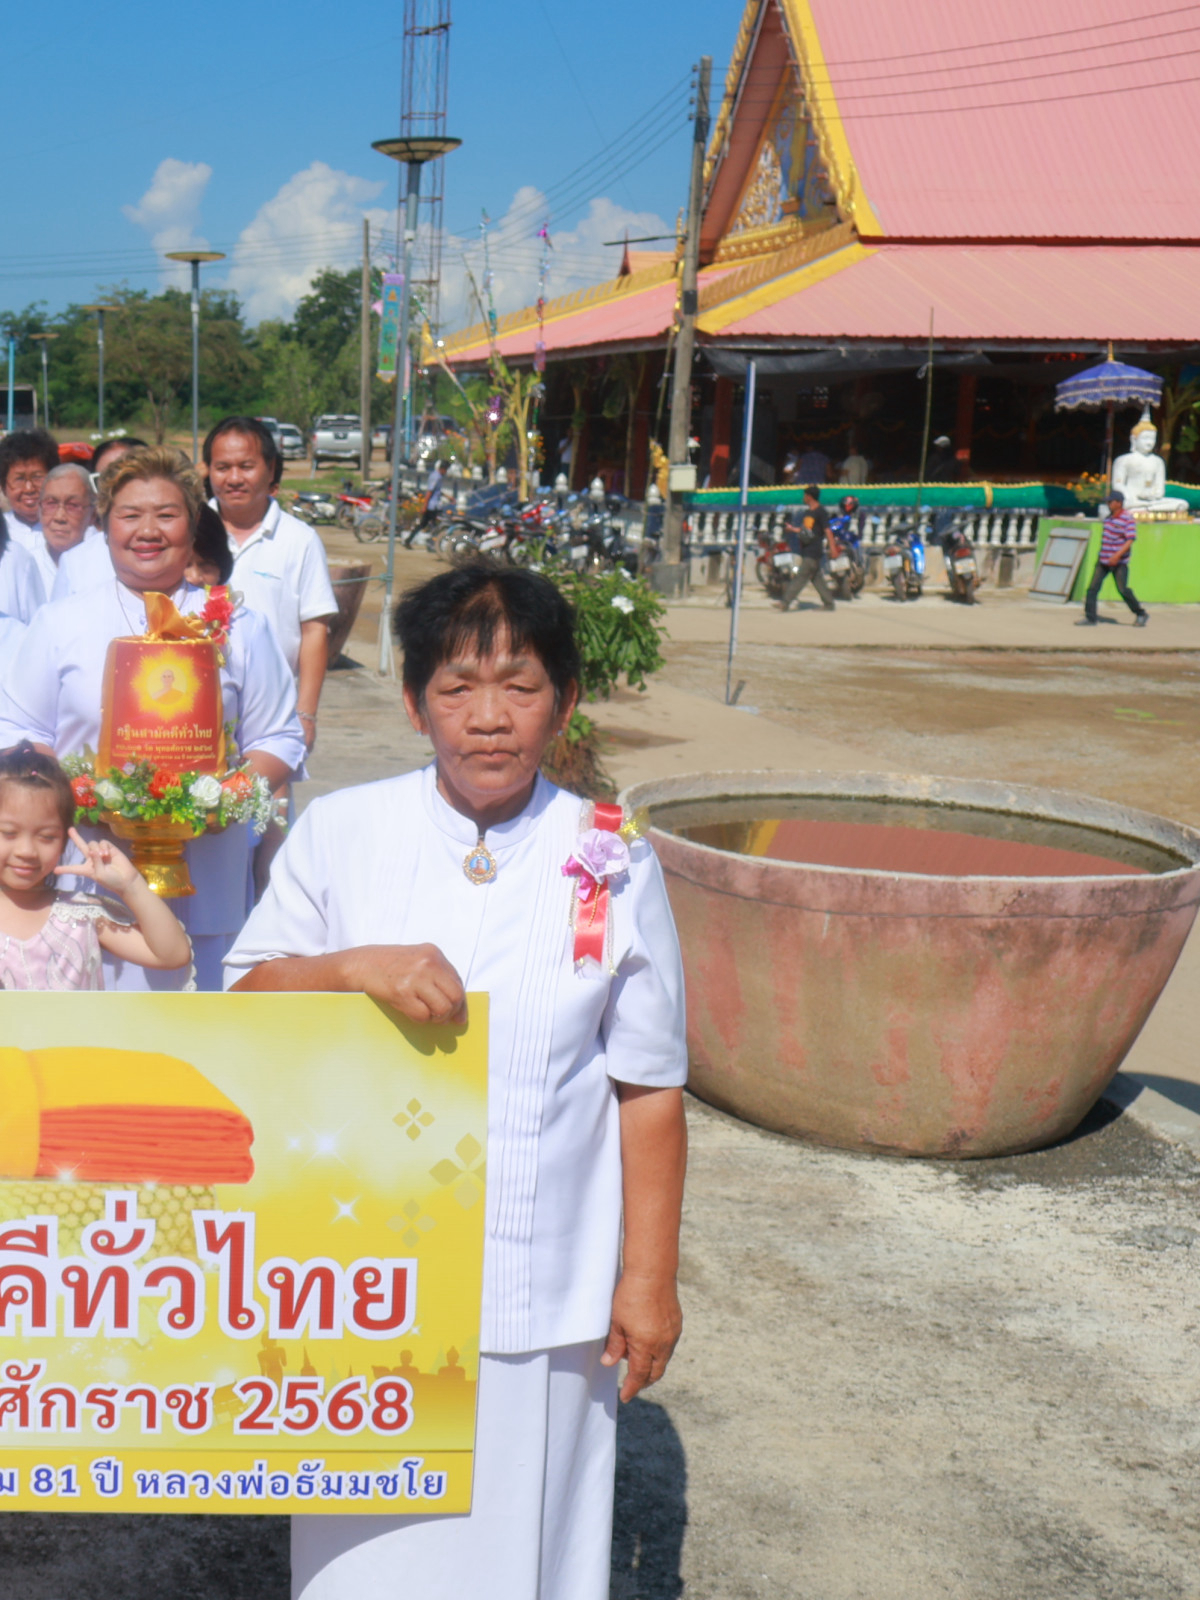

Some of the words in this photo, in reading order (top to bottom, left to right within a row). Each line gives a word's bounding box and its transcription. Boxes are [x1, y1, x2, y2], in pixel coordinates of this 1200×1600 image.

[236, 1380, 412, 1432] 2568
[33, 1467, 78, 1494] 81
[94, 1460, 120, 1495] ปี
[136, 1459, 444, 1497] หลวงพ่อธัมมชโย
